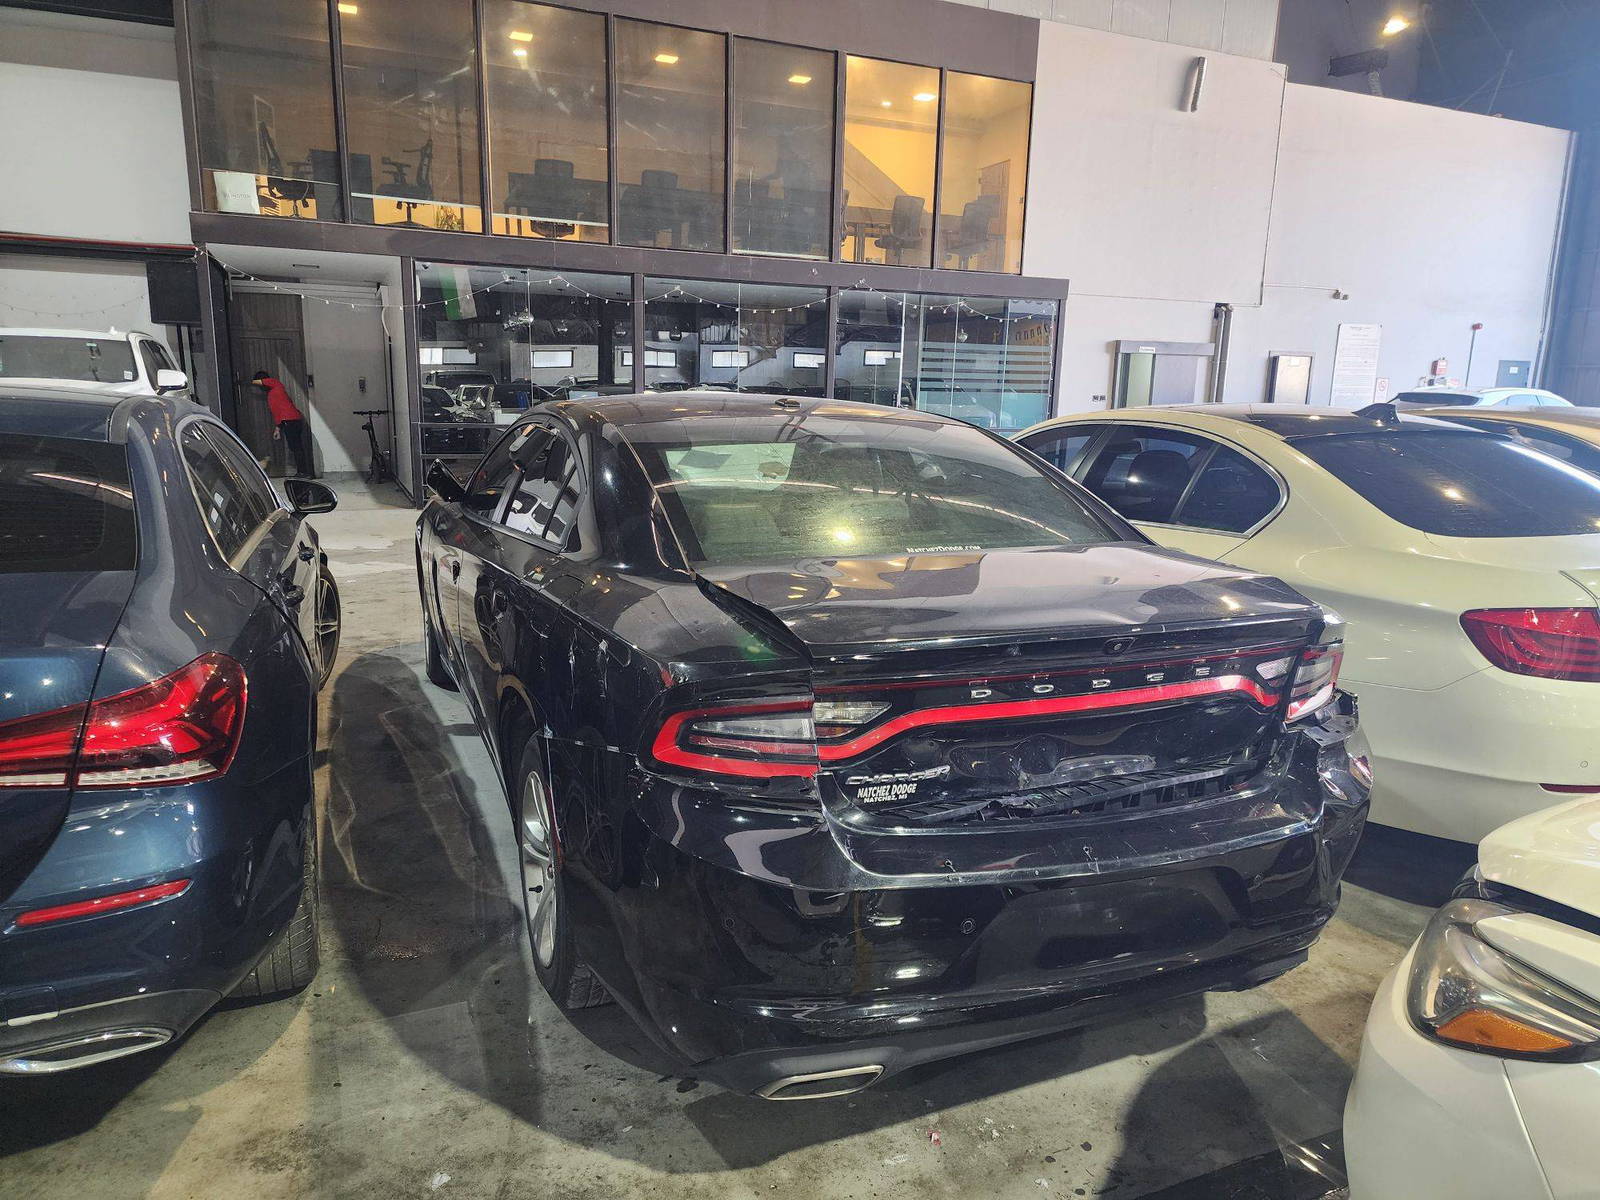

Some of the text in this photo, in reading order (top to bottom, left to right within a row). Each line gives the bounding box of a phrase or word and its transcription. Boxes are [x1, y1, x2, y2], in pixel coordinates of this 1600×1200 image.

[971, 667, 1211, 698] DODGE
[845, 765, 951, 785] CHARGER
[857, 783, 917, 798] NATCHEZ DODGE
